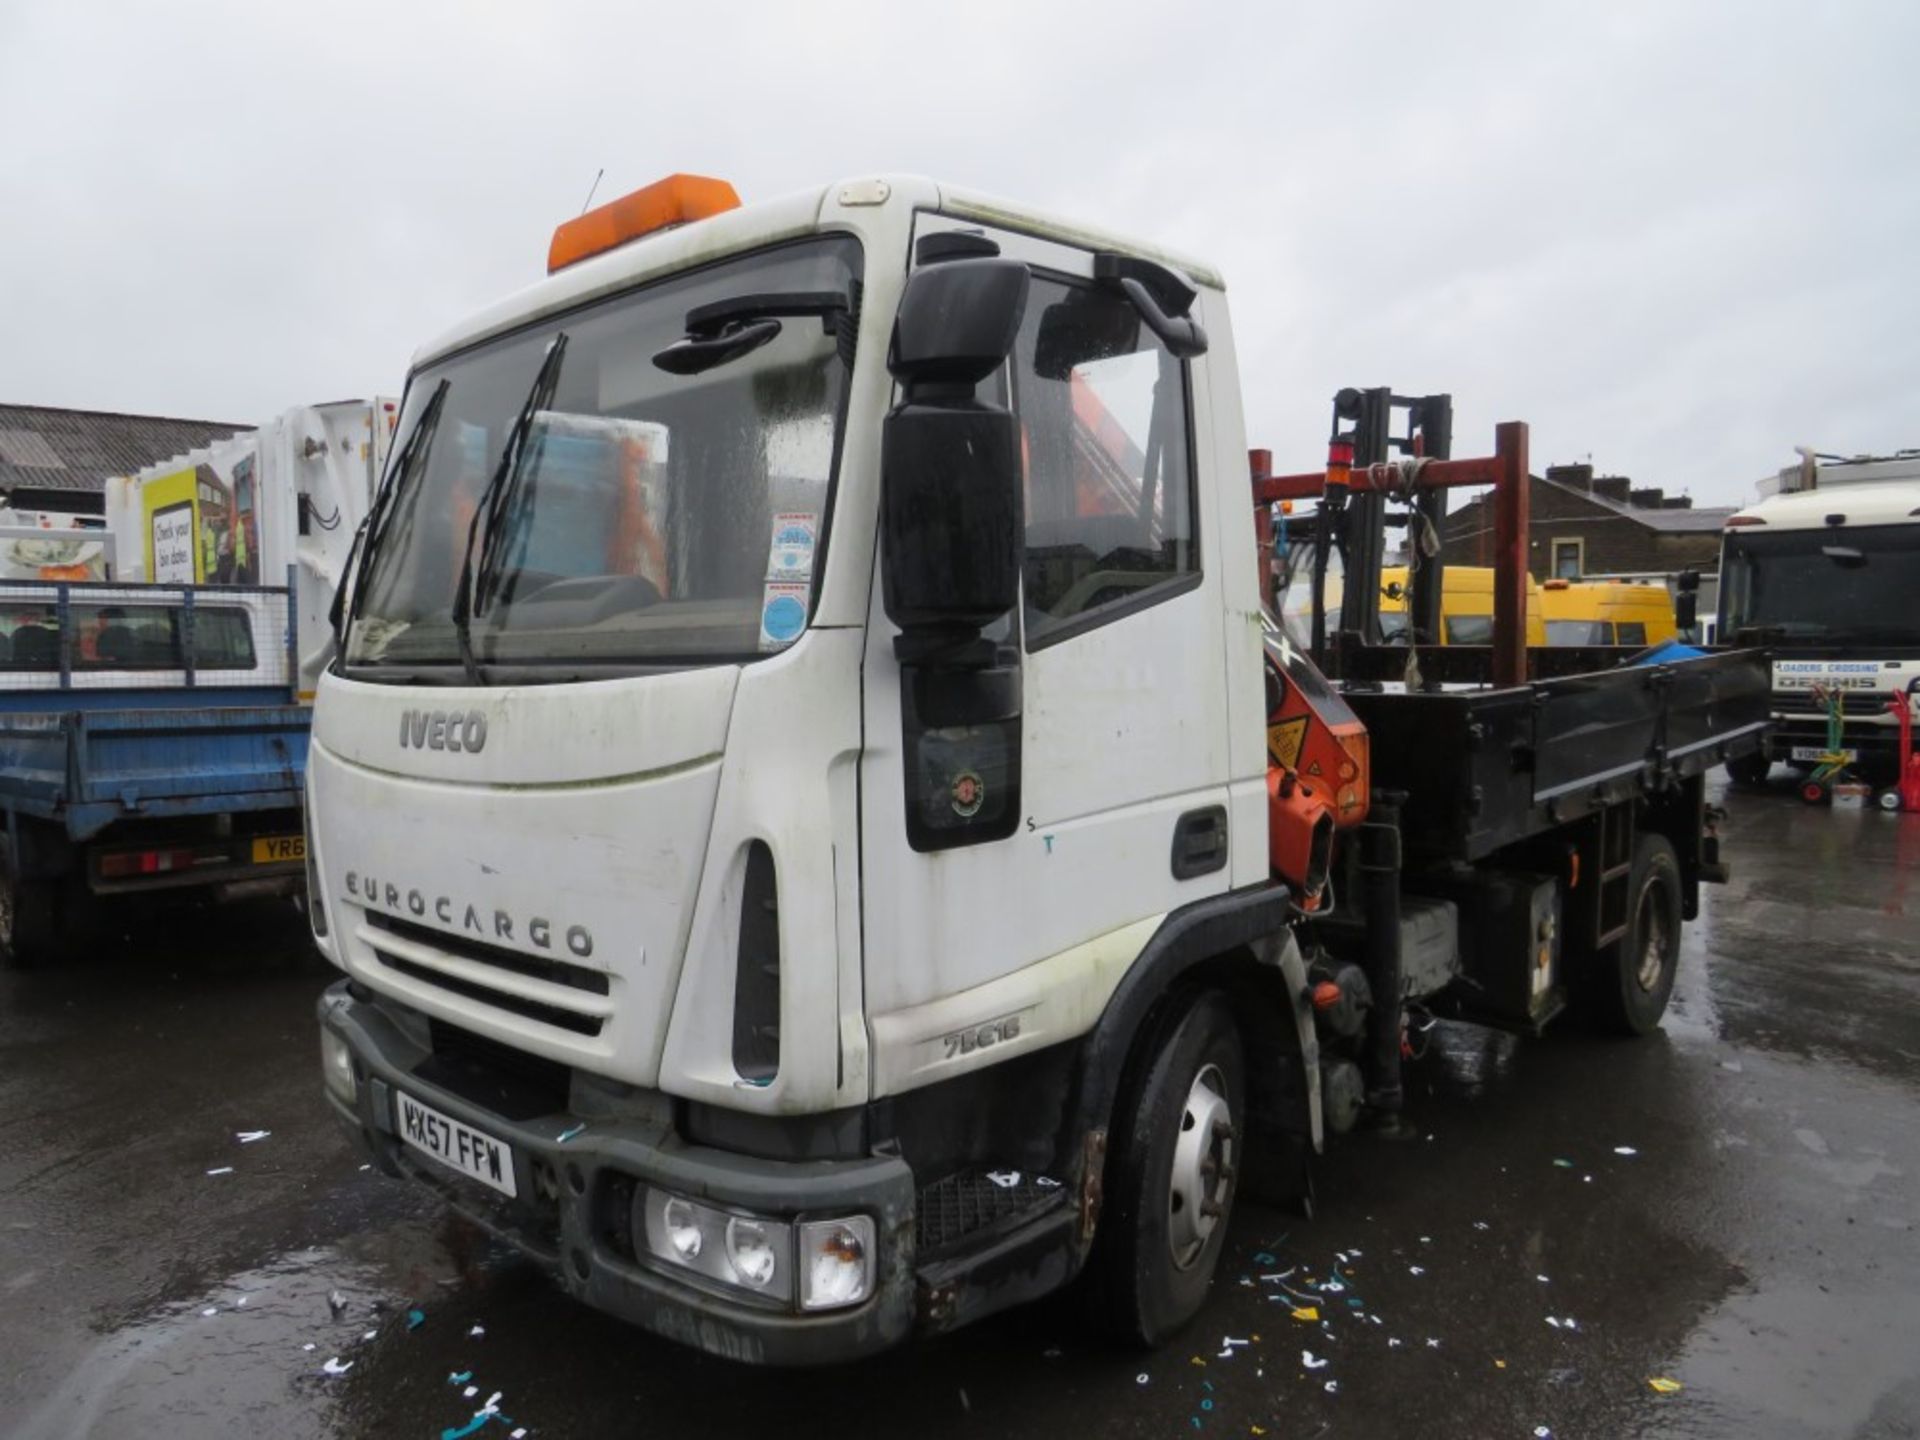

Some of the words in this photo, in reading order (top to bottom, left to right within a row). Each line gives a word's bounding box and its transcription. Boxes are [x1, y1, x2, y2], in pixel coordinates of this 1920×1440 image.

[156, 520, 173, 542] Check
[175, 521, 189, 541] your
[1828, 664, 1879, 673] CROSSING
[1779, 677, 1876, 688] DENNIS
[400, 710, 487, 753] IVECO
[345, 871, 594, 958] EUROCARGO
